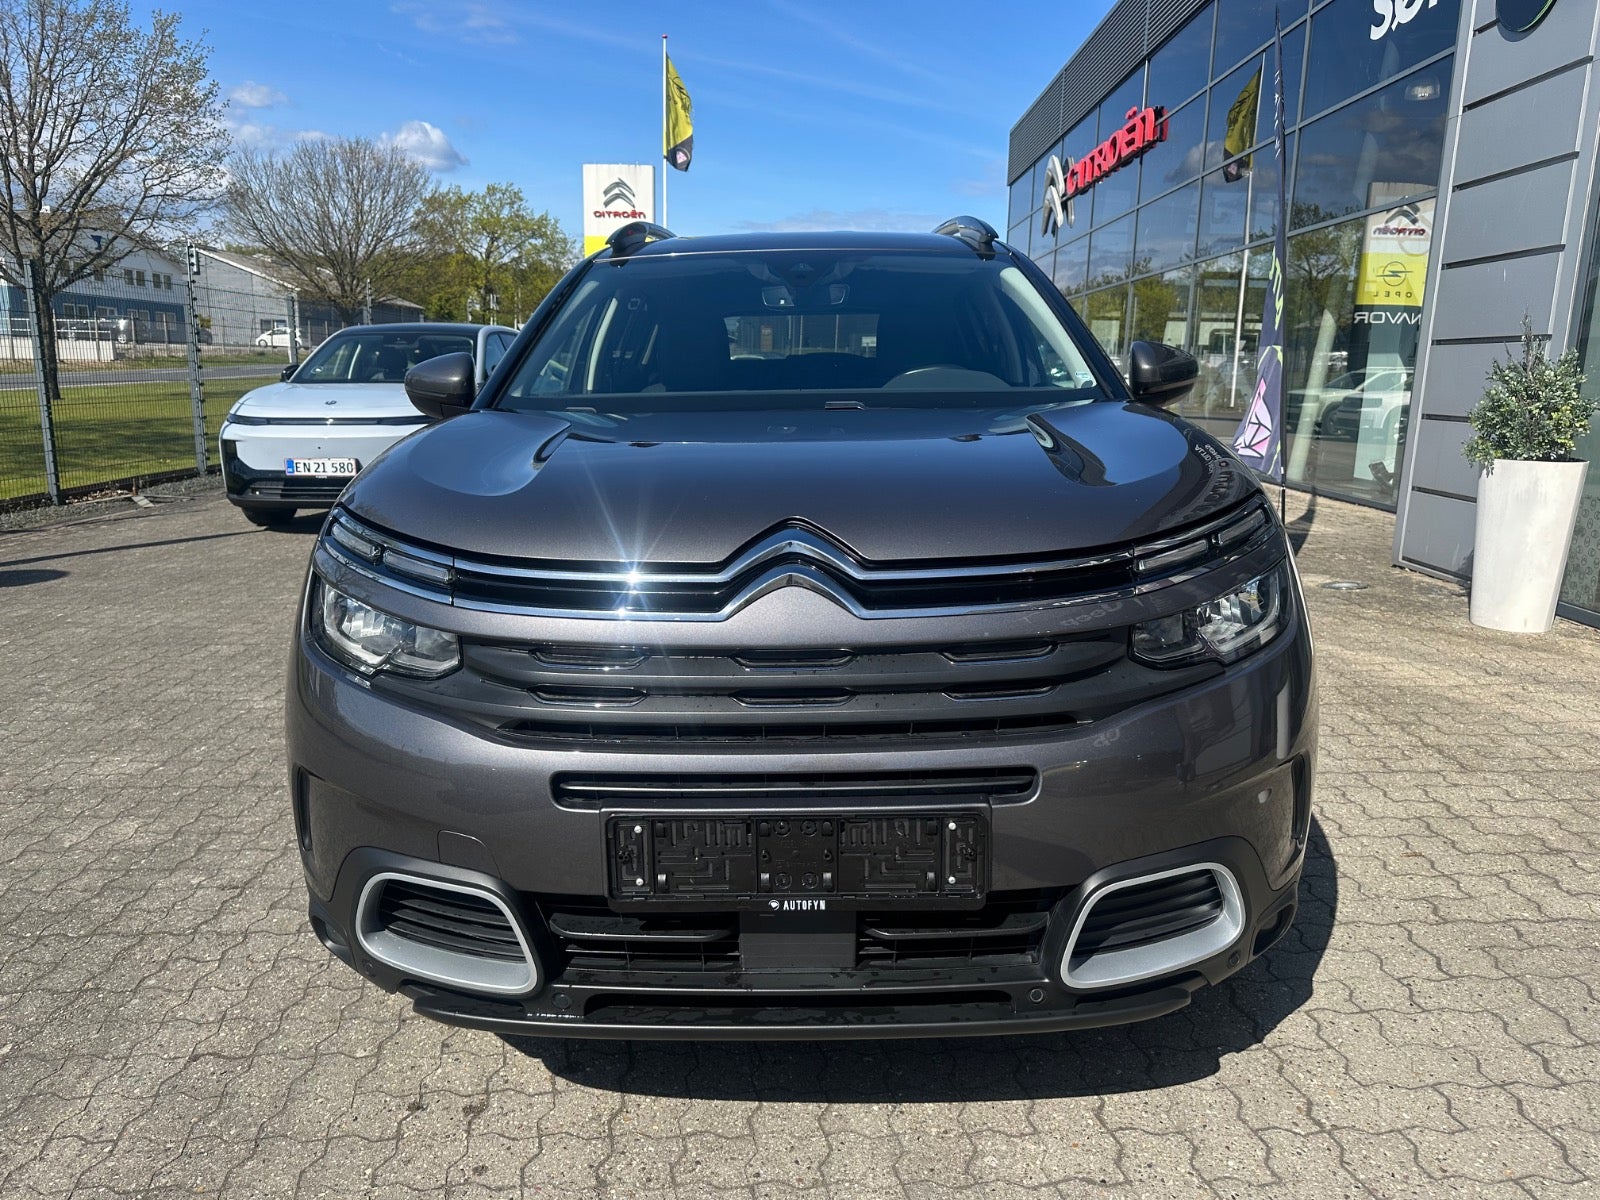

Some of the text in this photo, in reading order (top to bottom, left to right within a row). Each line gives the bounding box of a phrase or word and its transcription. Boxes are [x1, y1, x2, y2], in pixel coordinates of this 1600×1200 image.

[1066, 106, 1156, 195] CITROËN
[593, 209, 646, 219] CITROËN
[295, 462, 354, 473] EN 21 580
[783, 900, 826, 910] AUTOFYN
